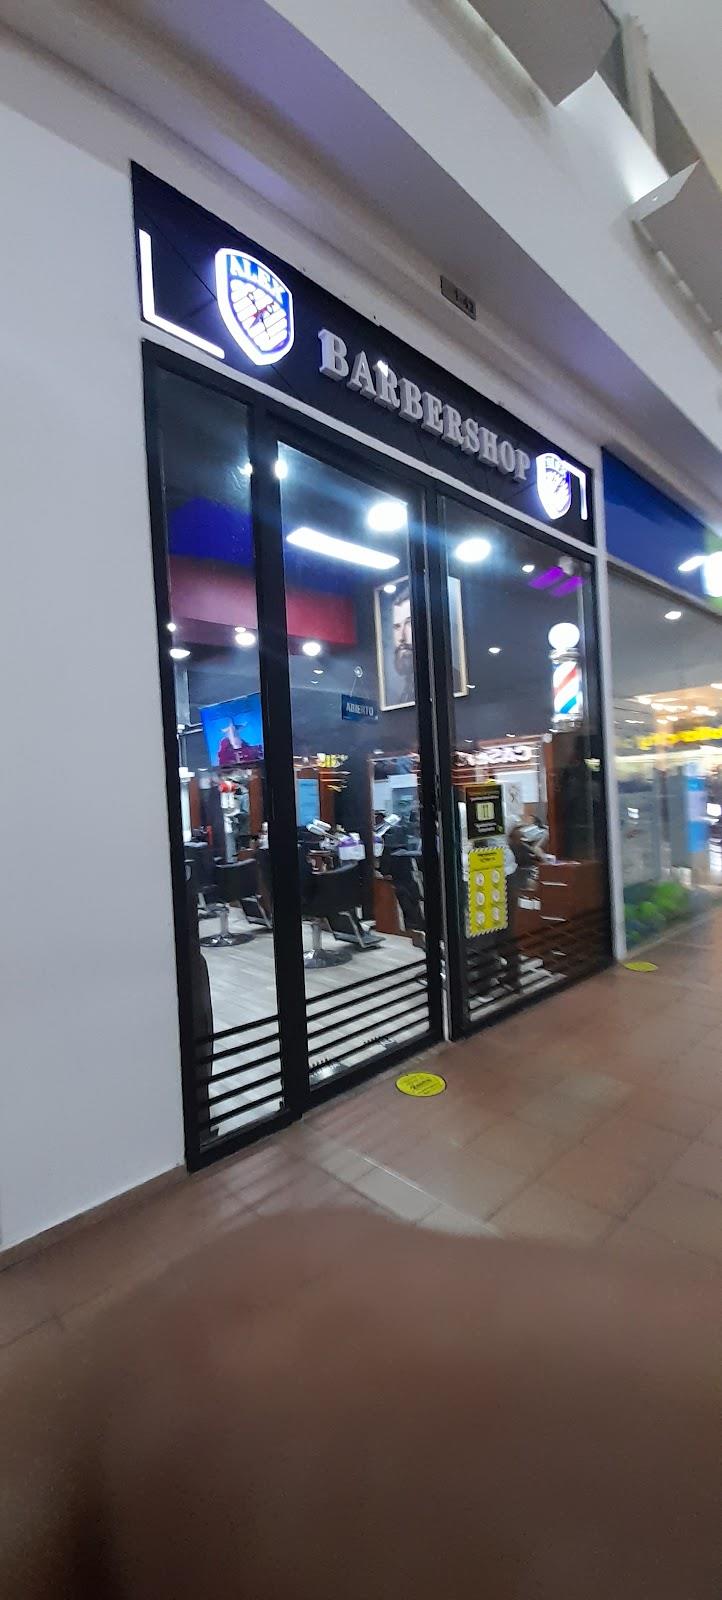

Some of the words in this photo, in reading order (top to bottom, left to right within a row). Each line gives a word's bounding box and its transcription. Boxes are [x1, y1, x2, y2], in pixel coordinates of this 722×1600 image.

[229, 254, 287, 305] ALEX
[318, 328, 531, 481] BARBERSHOP
[345, 702, 374, 717] ABIERTO
